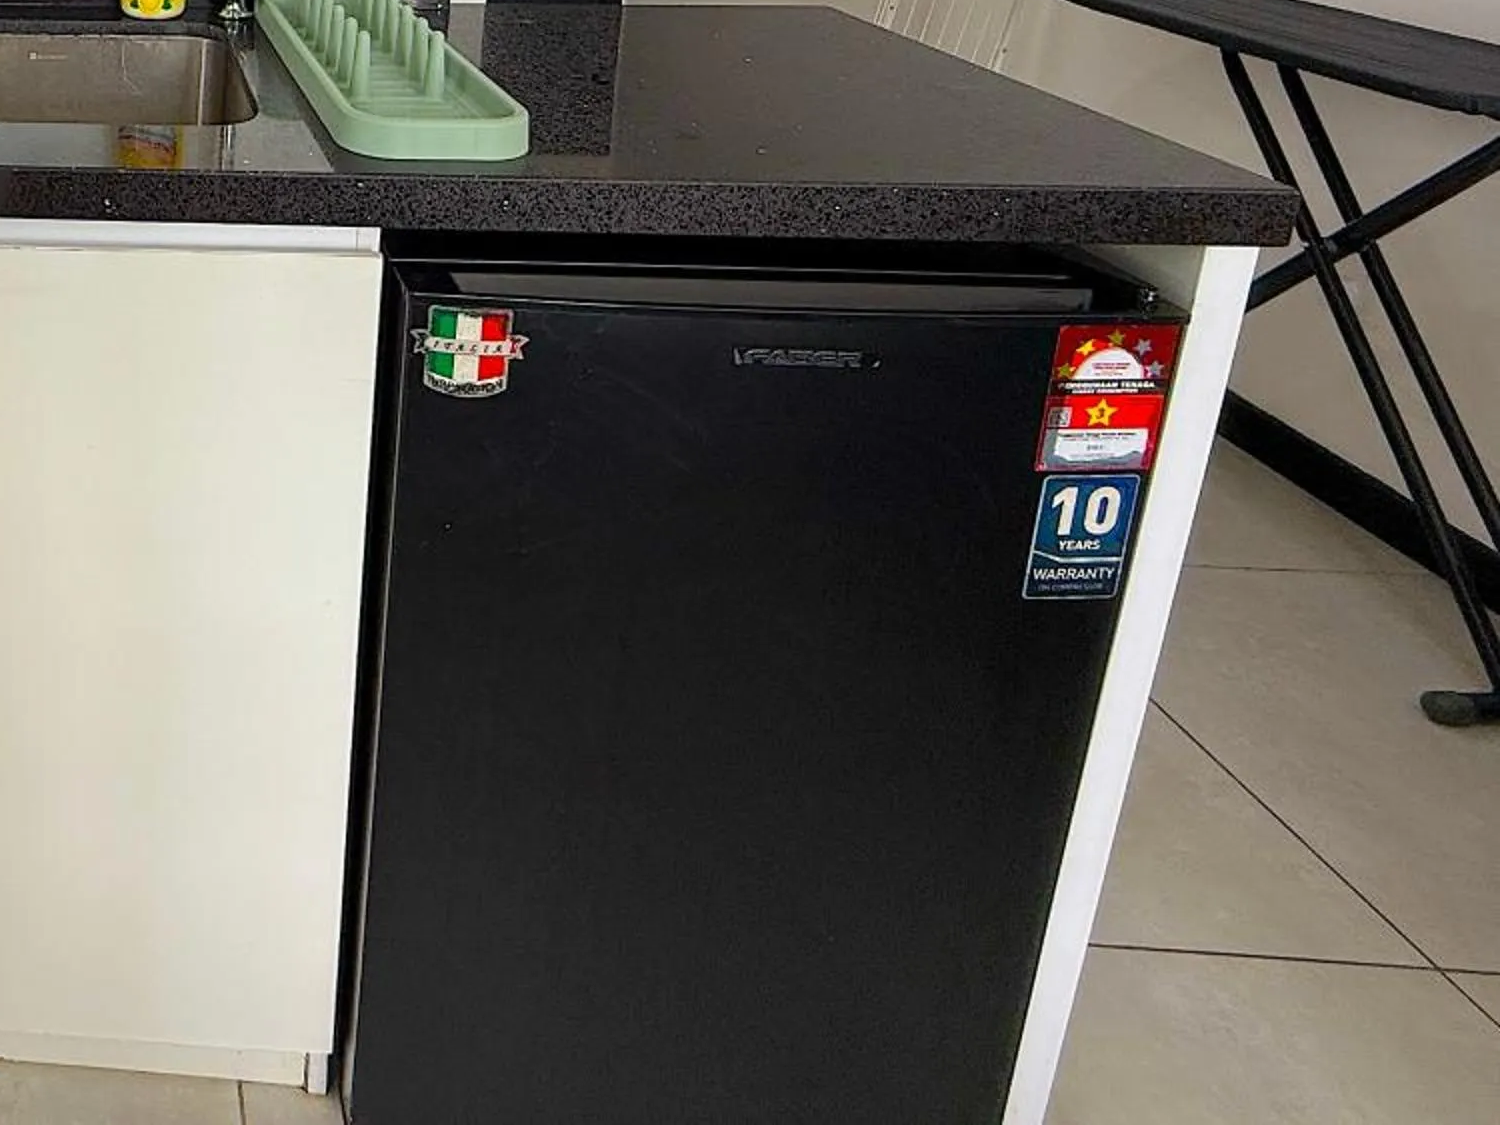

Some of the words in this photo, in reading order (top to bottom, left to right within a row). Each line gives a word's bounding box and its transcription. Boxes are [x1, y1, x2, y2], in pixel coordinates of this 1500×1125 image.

[1051, 486, 1122, 536] 10
[1059, 539, 1101, 551] YEARS
[1032, 566, 1115, 581] WARRANTY
